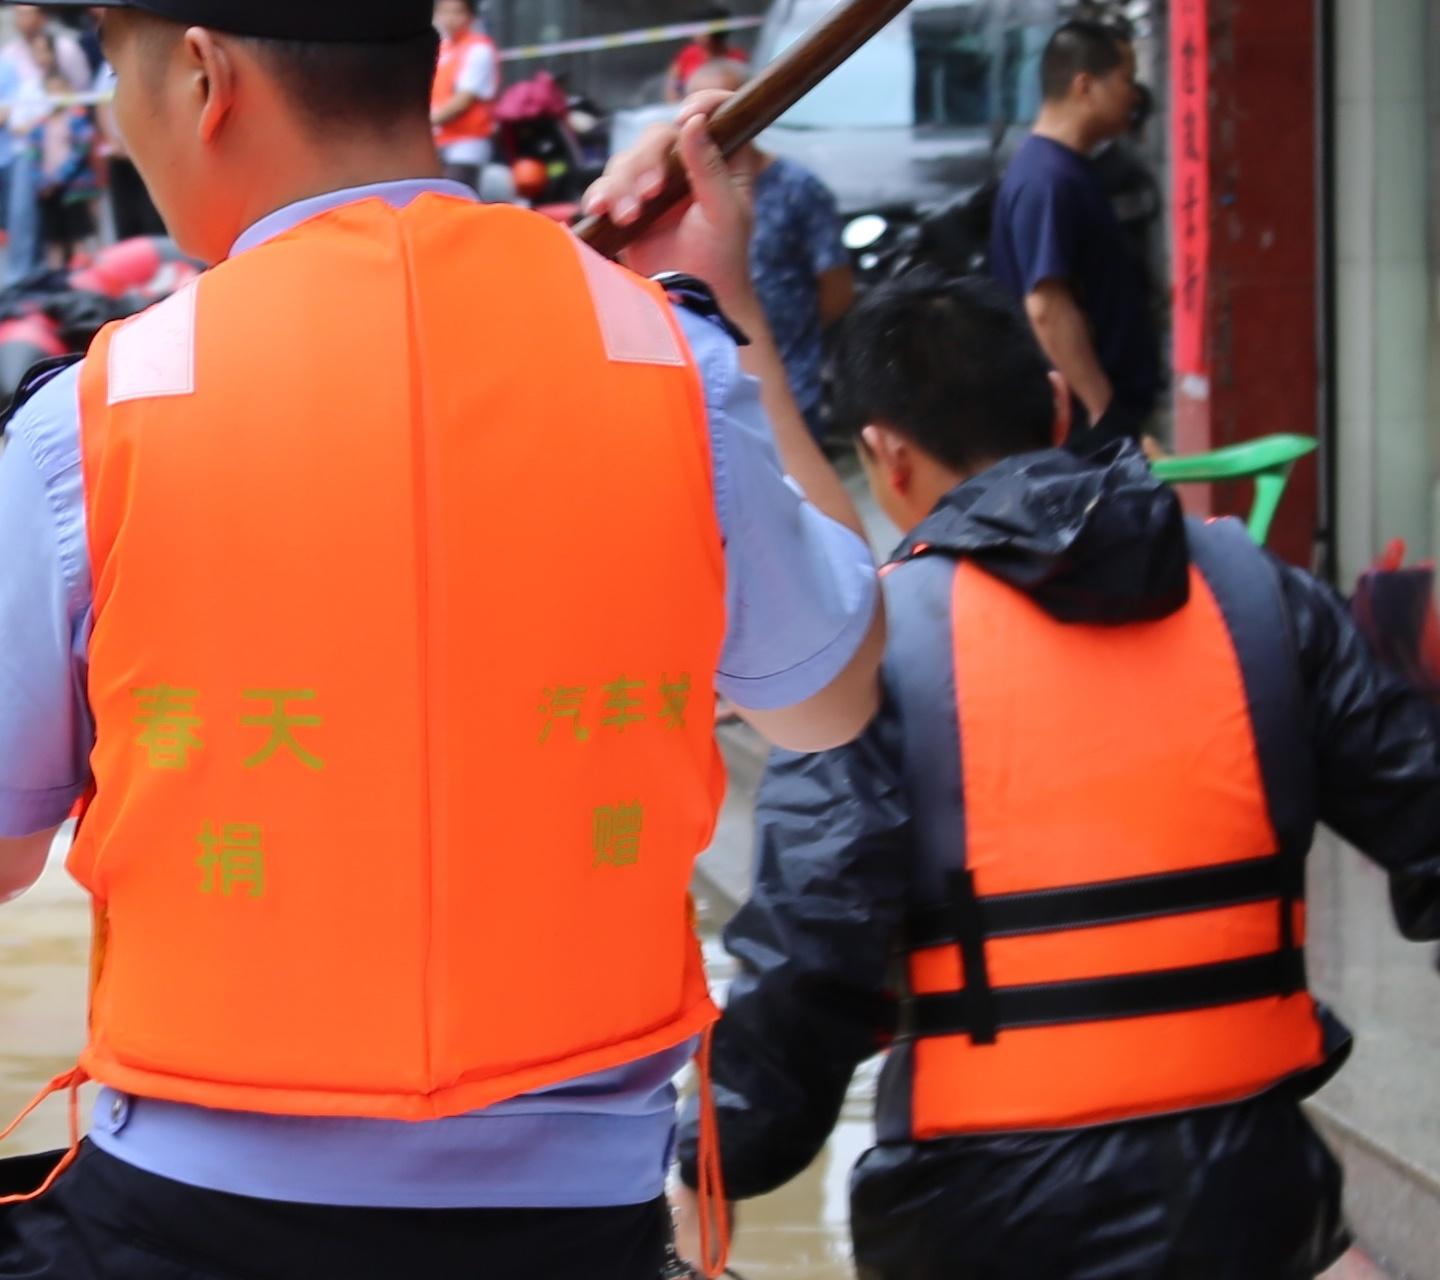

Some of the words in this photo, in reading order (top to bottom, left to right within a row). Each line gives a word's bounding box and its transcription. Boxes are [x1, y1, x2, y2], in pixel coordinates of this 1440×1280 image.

[129, 683, 326, 771] 春天
[194, 821, 265, 898] 捐
[591, 799, 644, 869] 赠
